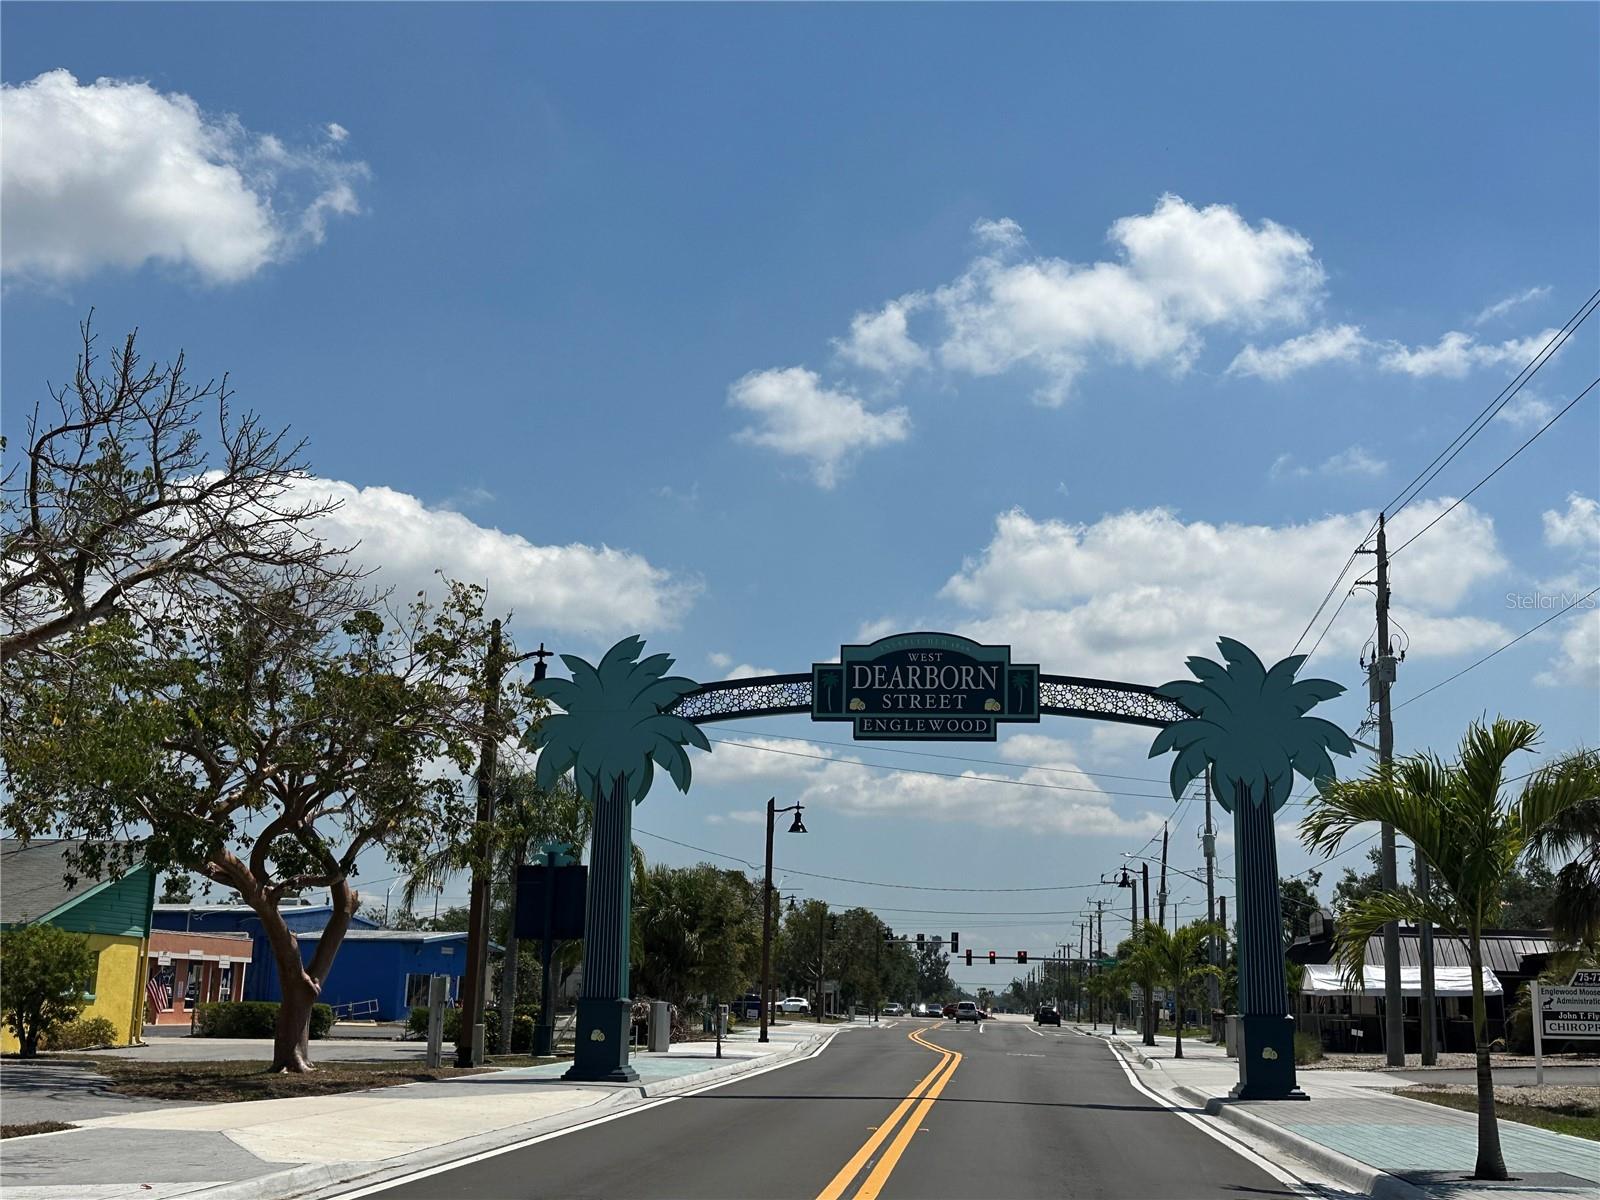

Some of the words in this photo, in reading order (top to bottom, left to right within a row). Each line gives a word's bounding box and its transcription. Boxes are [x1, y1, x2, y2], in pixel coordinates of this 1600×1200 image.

[908, 652, 943, 662] WEST
[852, 665, 999, 690] DEARBORN
[882, 694, 967, 709] STREET
[863, 719, 987, 732] ENGLEWOOD
[1541, 988, 1577, 996] Englewood
